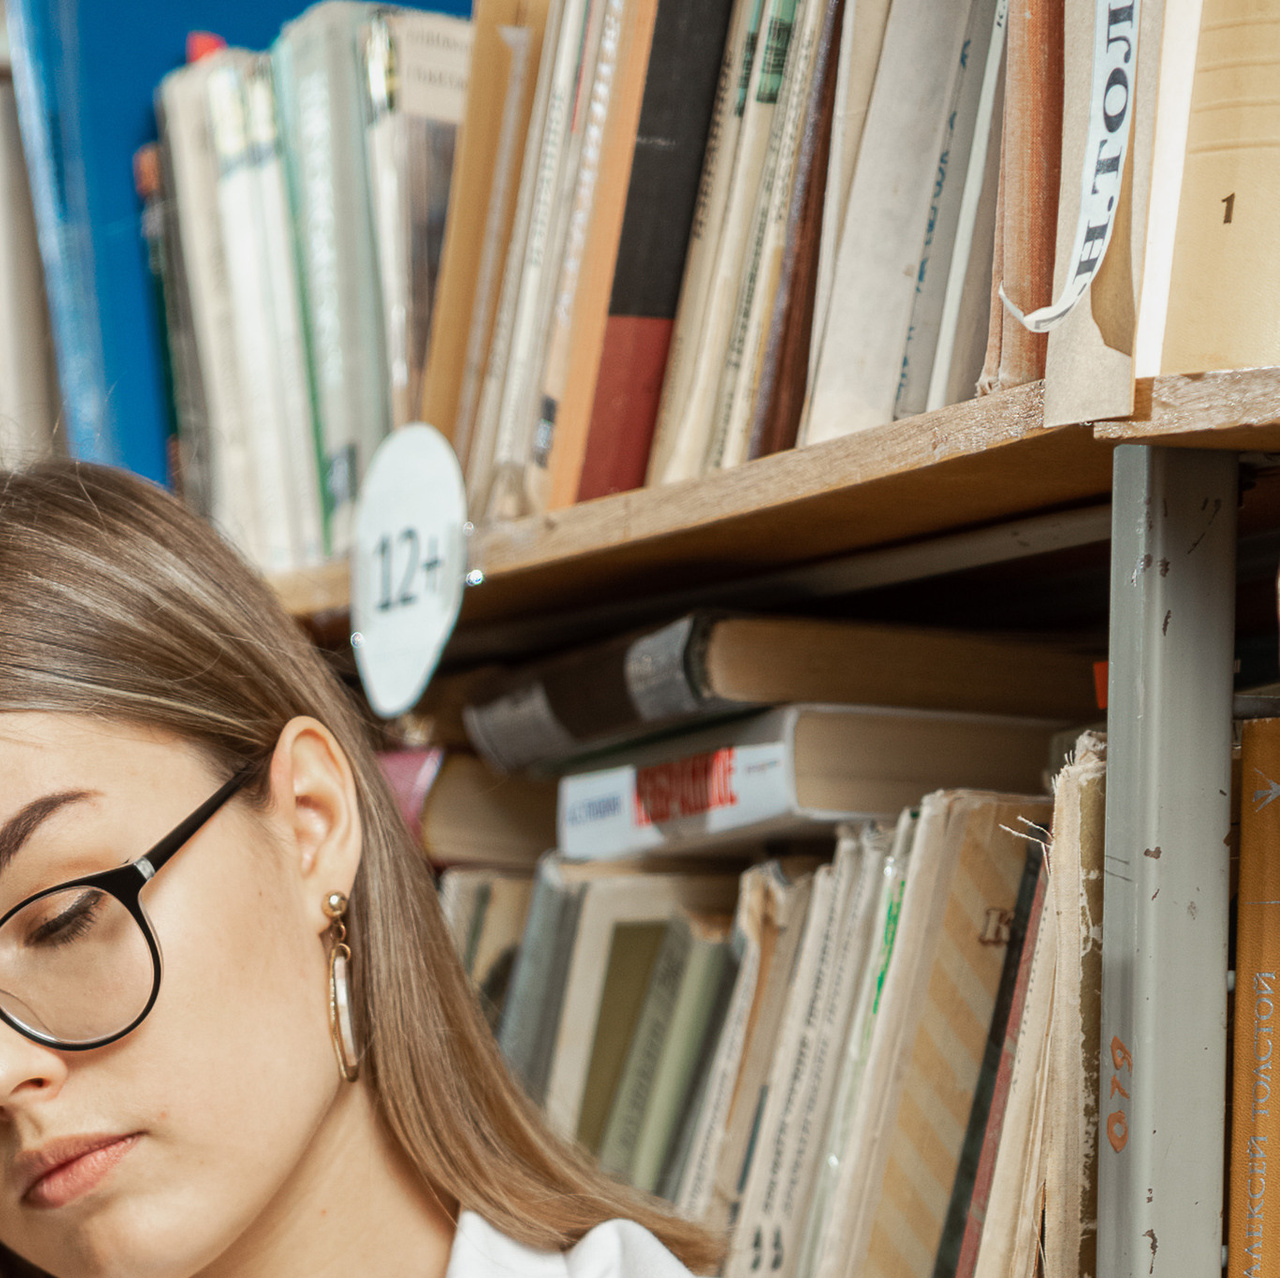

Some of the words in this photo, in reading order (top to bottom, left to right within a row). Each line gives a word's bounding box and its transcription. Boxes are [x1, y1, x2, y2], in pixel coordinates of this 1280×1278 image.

[1220, 192, 1237, 225] 1
[373, 524, 444, 613] 12+
[1251, 971, 1277, 1123] ТОЛСТОЙ
